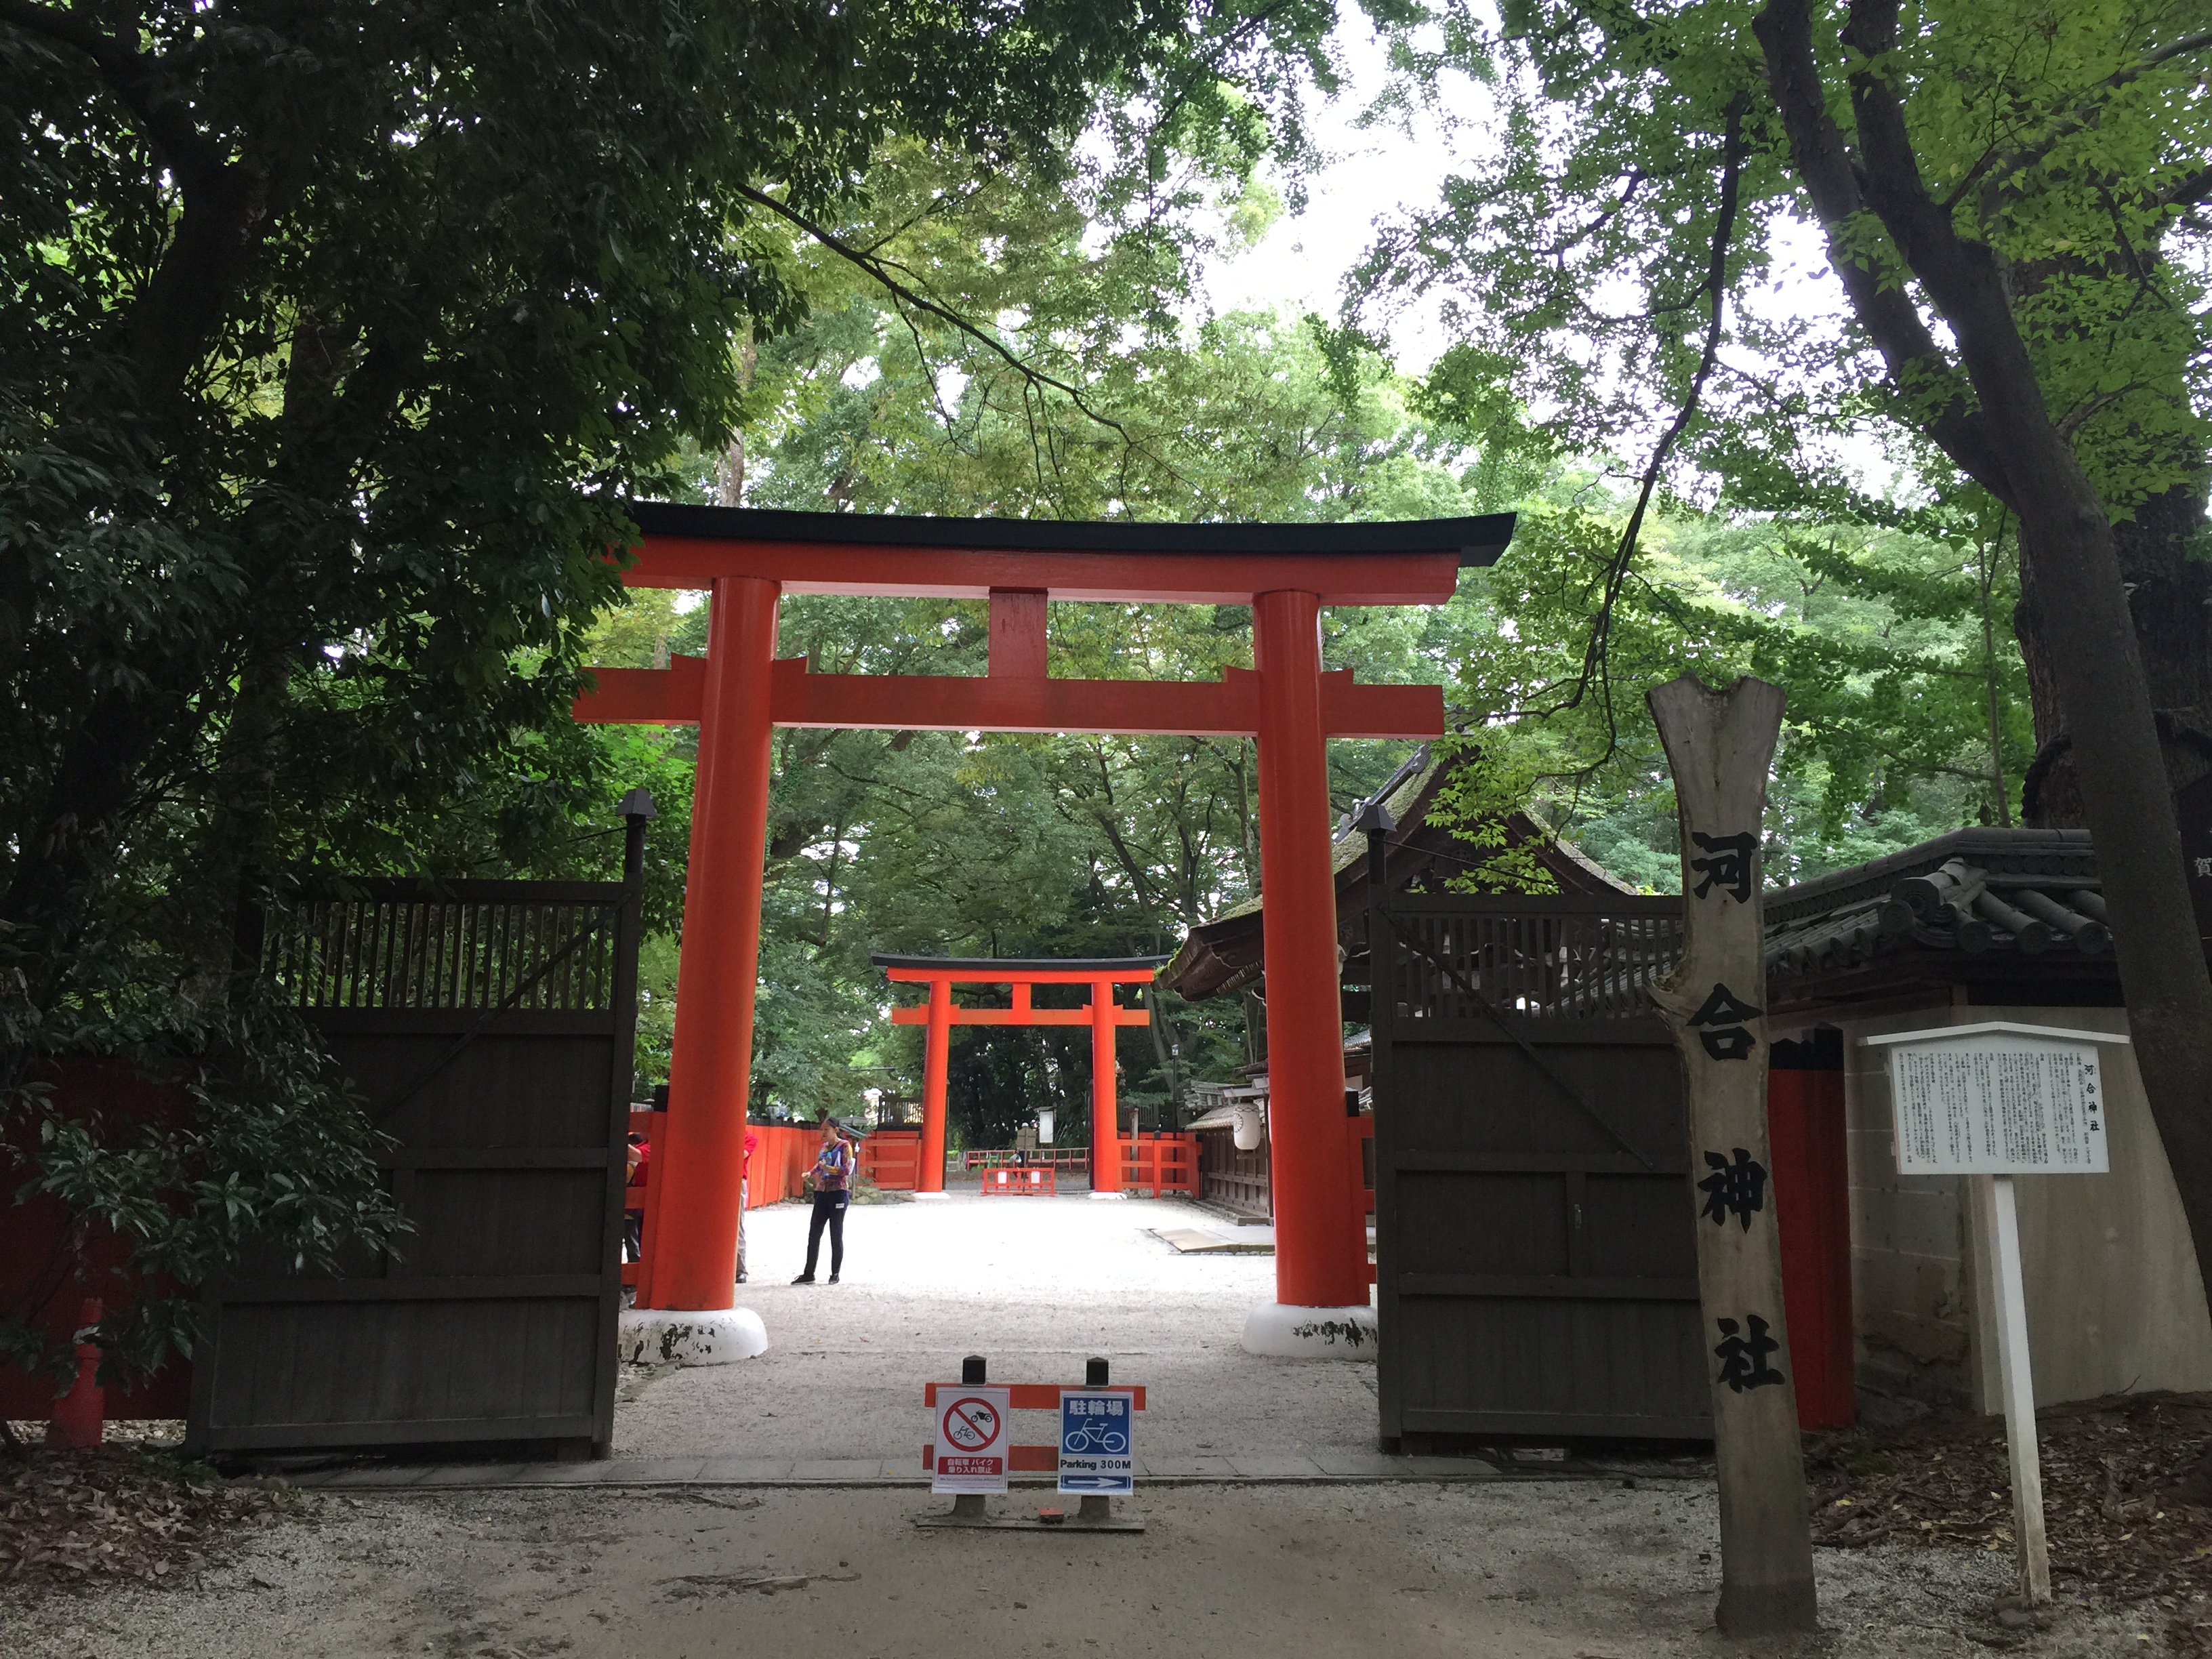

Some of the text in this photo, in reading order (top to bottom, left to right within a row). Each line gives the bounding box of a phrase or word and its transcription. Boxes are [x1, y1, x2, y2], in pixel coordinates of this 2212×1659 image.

[1686, 831, 1786, 1395] 河合神社
[2084, 1064, 2100, 1132] 河合神社
[1069, 1399, 1124, 1416] 駐輪場
[1060, 1460, 1131, 1471] Parking 300M
